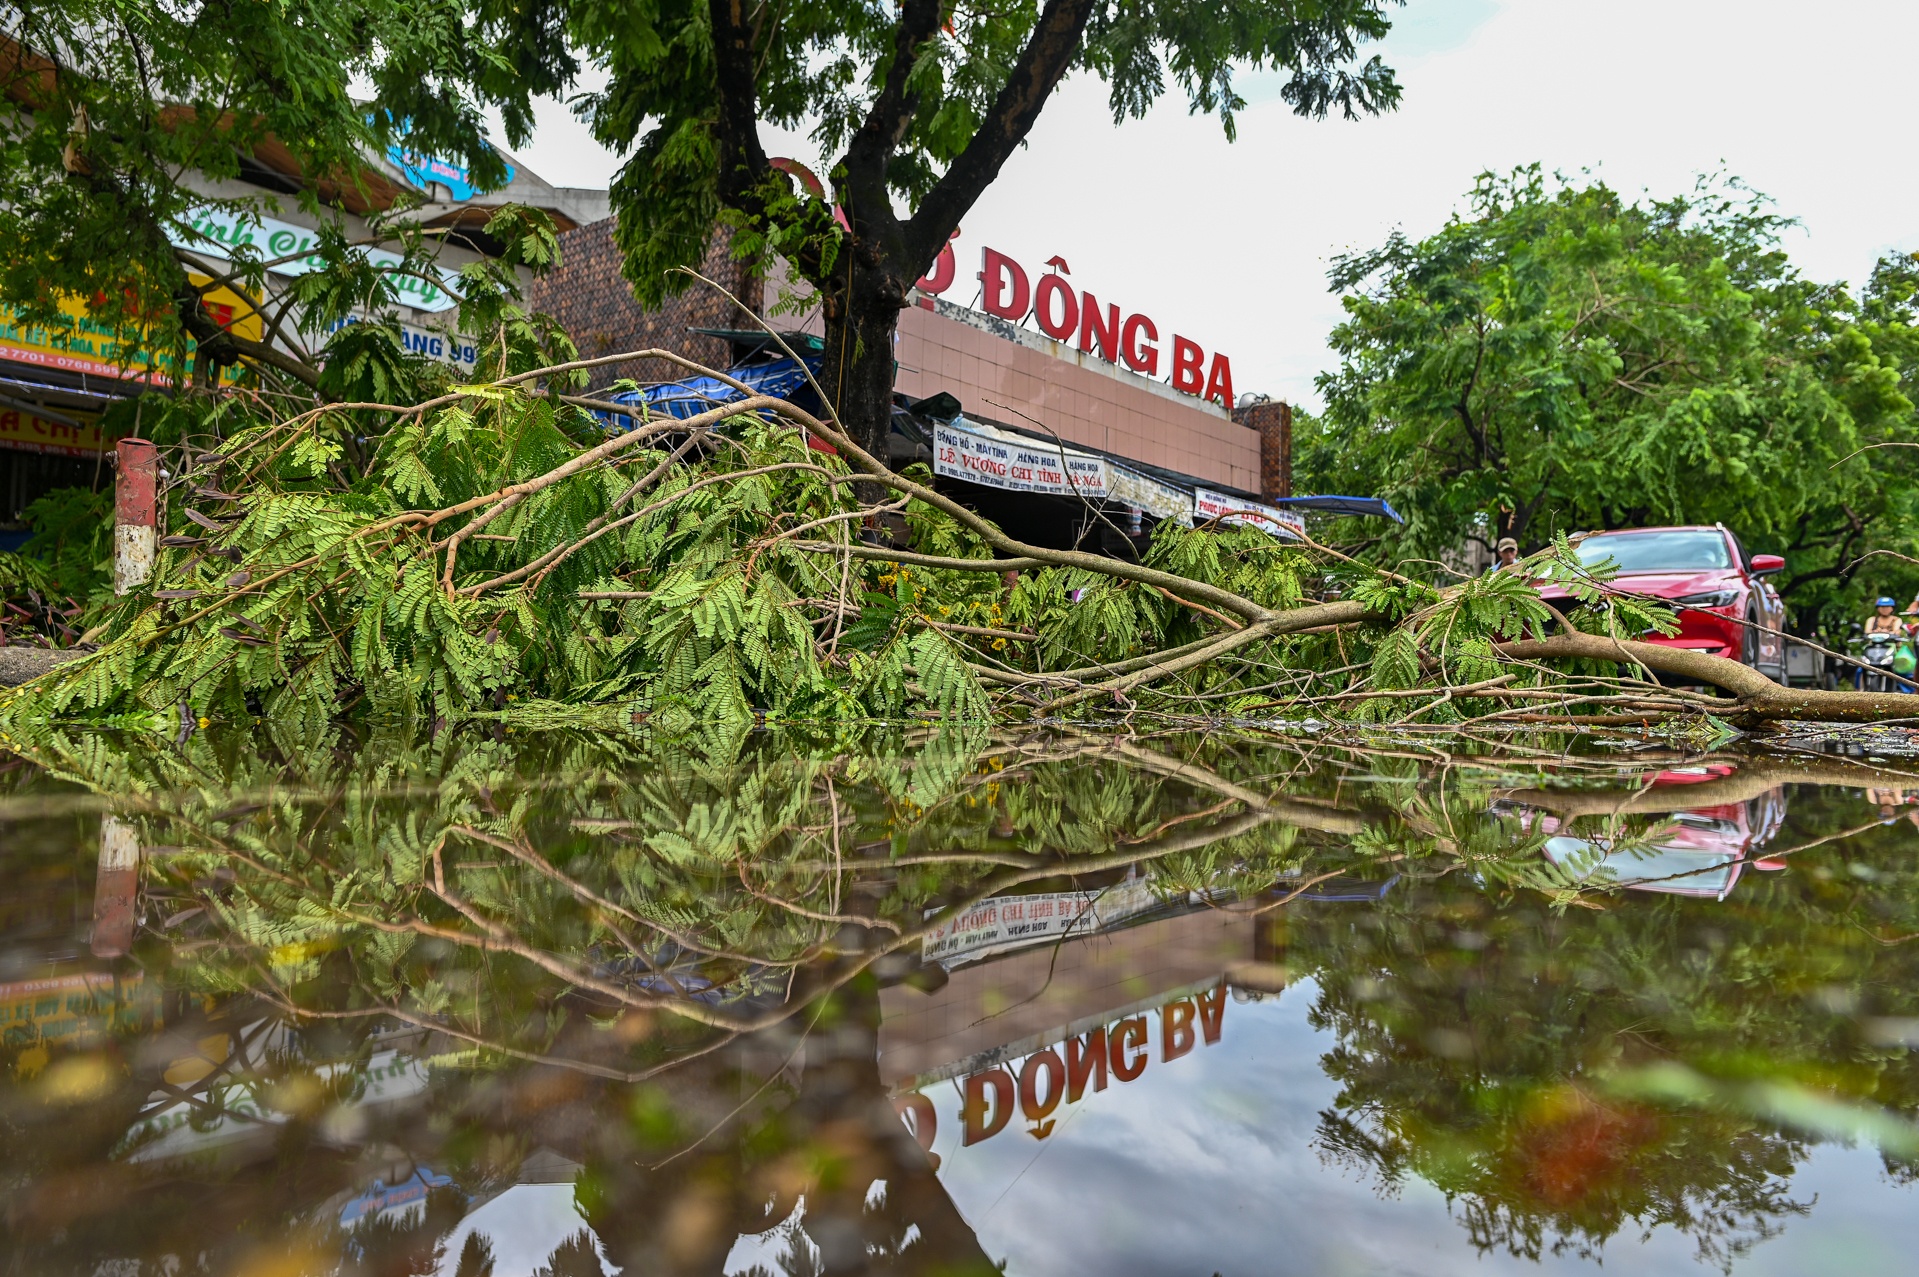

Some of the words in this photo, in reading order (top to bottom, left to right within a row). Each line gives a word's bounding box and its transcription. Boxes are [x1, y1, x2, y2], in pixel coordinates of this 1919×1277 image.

[976, 246, 1158, 377] ĐÔNG
[1171, 333, 1234, 409] BA
[939, 447, 956, 464] LÊ
[962, 454, 1007, 477] VƯƠNG
[1011, 466, 1033, 484] CHỊ
[1037, 467, 1062, 484] TÌNH
